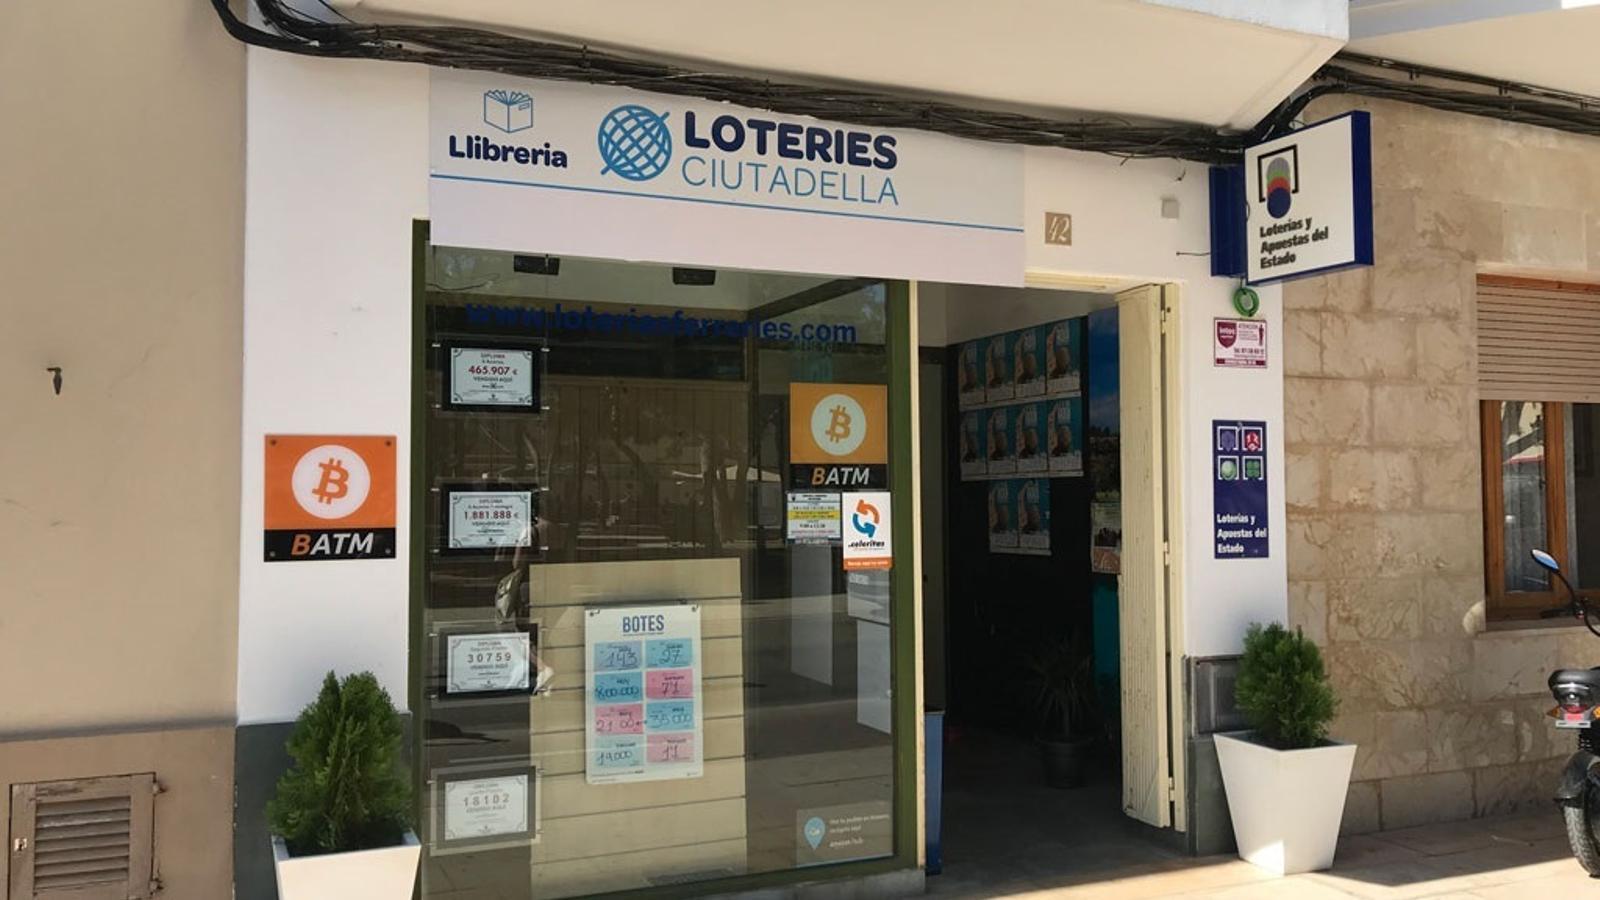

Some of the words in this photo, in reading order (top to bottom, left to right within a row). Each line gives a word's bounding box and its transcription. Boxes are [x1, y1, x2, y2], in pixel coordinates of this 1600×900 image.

[684, 110, 898, 170] LOTERIES
[449, 134, 568, 169] Llibreria
[682, 155, 899, 206] CIUTADELLA
[1305, 217, 1312, 231] y
[1260, 233, 1310, 254] Apuestas
[1311, 226, 1329, 242] del
[1260, 251, 1296, 270] Estado
[468, 365, 511, 375] 465.907
[811, 466, 870, 485] BATM
[464, 510, 512, 520] 1.881.888
[1250, 515, 1256, 525] y
[1216, 528, 1253, 541] Apuestas
[1254, 527, 1267, 538] del
[290, 532, 374, 556] BATM
[1217, 543, 1244, 554] Estado
[622, 614, 665, 633] BOTES
